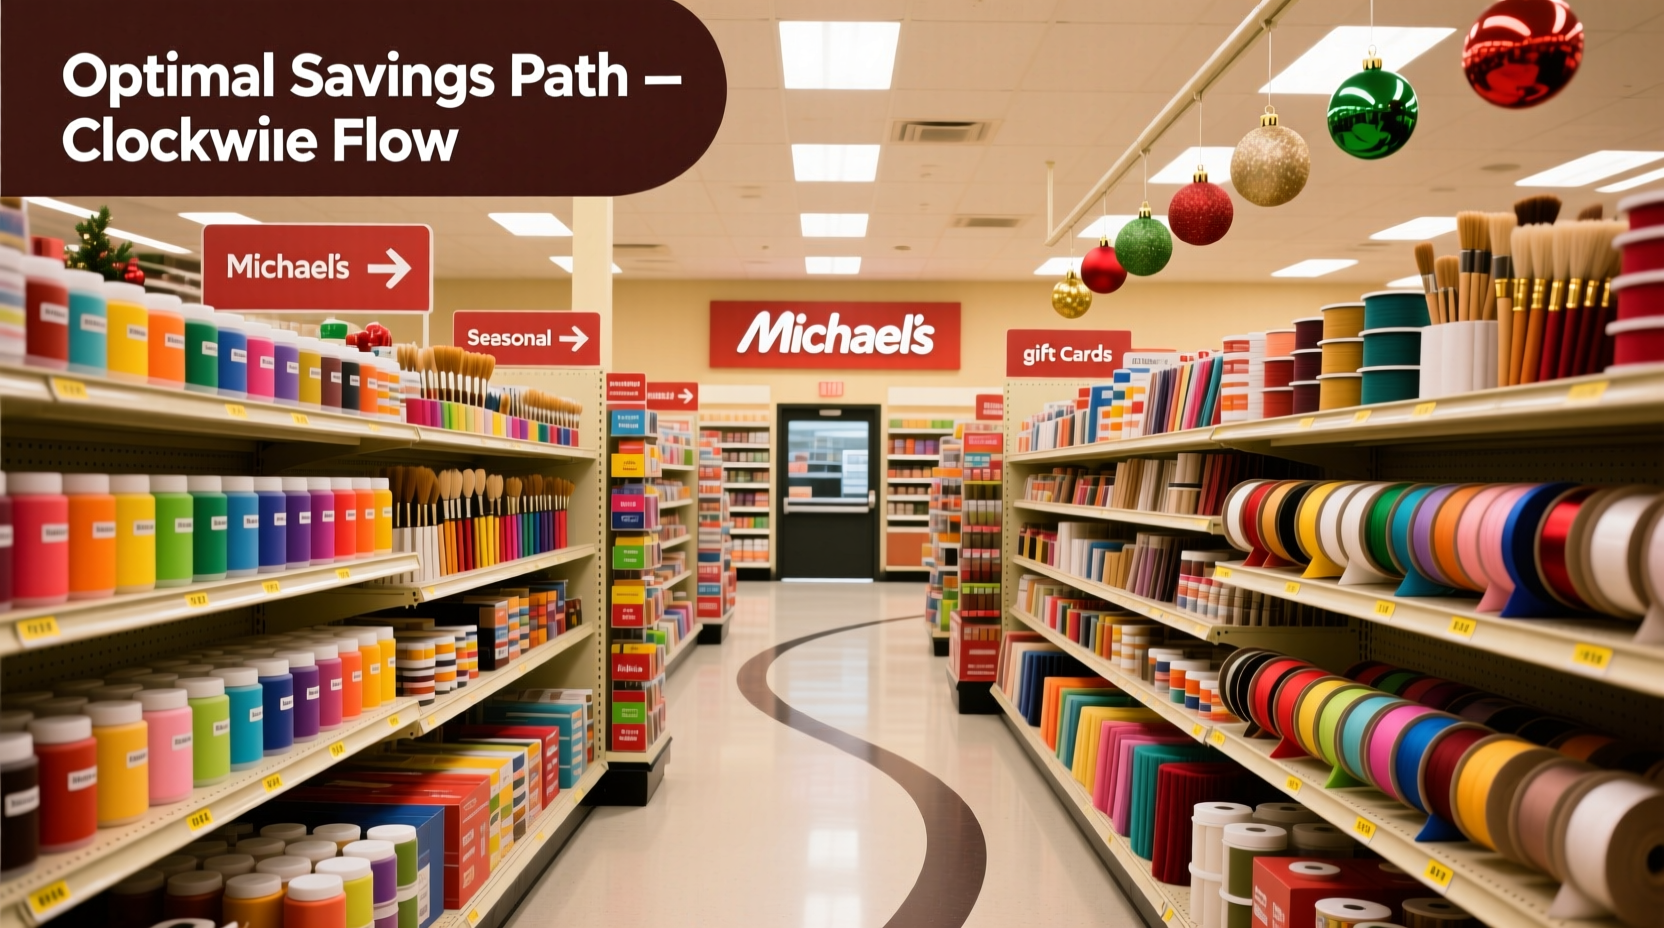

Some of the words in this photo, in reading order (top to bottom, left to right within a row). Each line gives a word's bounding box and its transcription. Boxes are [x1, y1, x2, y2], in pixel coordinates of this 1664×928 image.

[227, 253, 350, 279] Michael's
[467, 328, 552, 347] Seasonal
[736, 310, 935, 355] Michael's
[1023, 343, 1056, 366] gift
[1060, 344, 1113, 362] Cards
